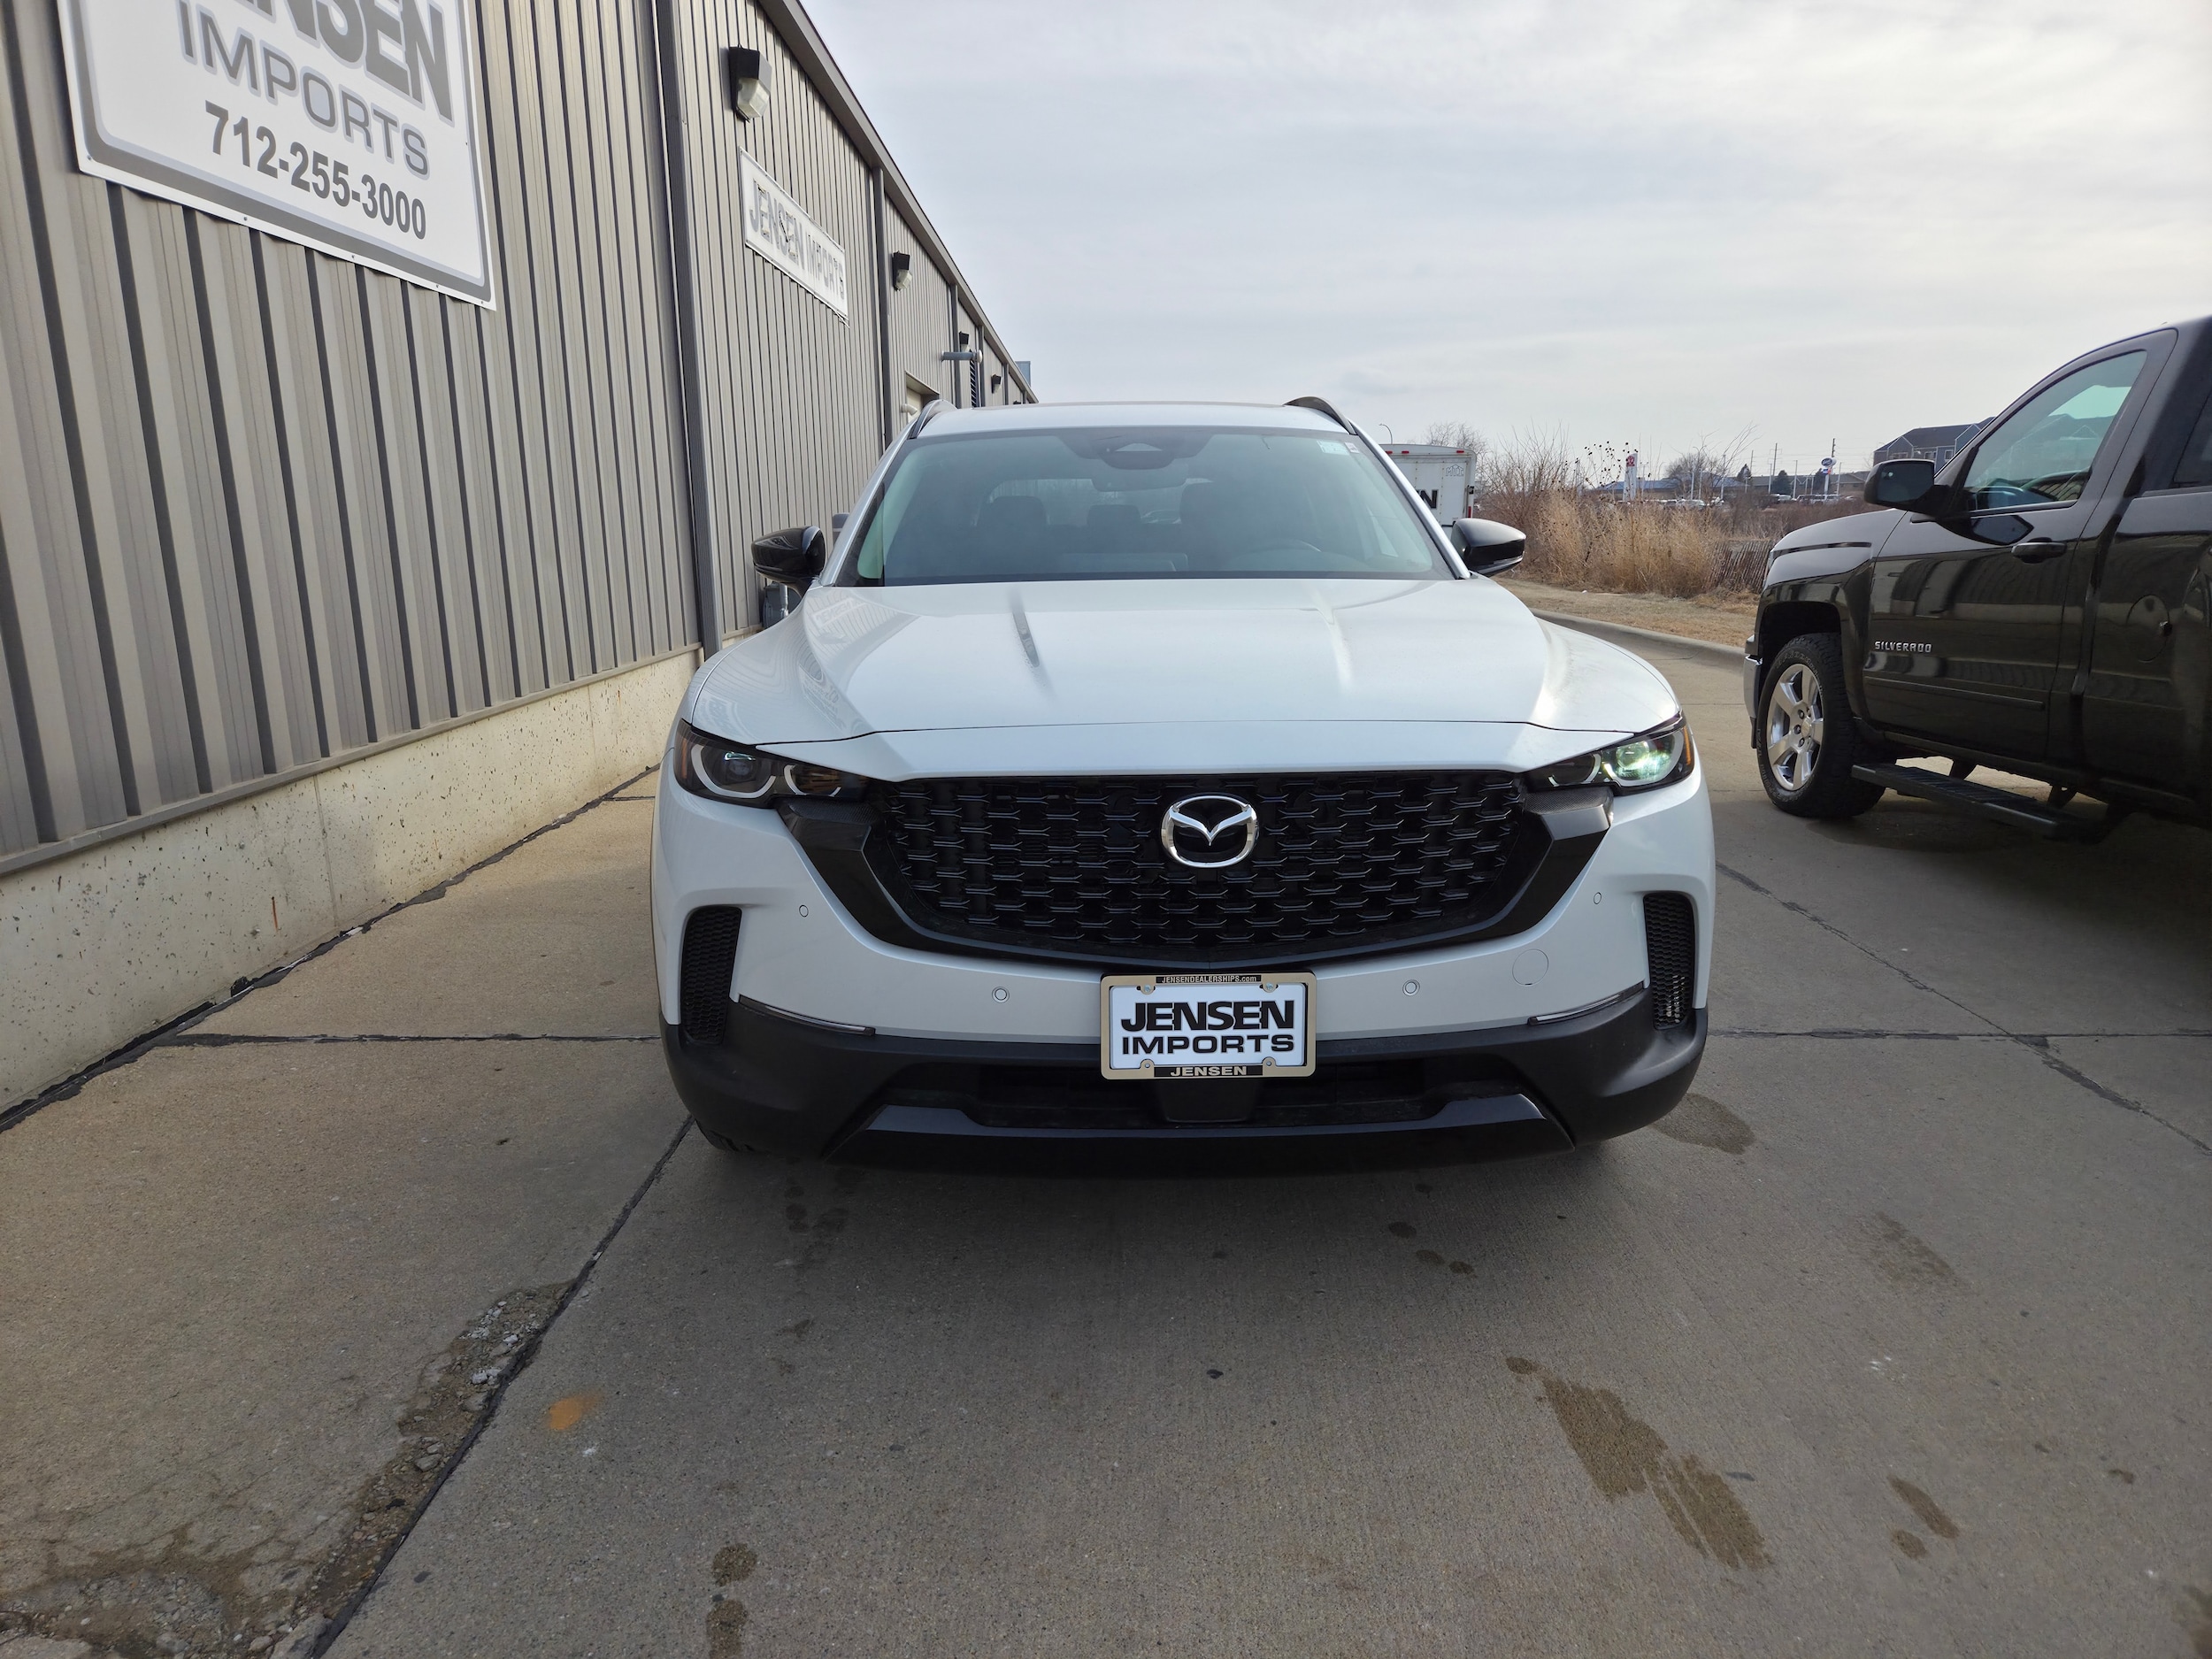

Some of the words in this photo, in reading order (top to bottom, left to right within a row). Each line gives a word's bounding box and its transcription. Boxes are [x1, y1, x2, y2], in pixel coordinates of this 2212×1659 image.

[178, 0, 429, 176] IMPORTS
[205, 100, 426, 240] 712-255-3000
[749, 178, 805, 271] JENSEN
[805, 231, 845, 300] IMPORTS
[1875, 641, 1932, 653] SILVERADO
[1162, 975, 1257, 984] JENSENDEALERSHIPS.com
[1120, 1000, 1295, 1033] JENSEN
[1122, 1033, 1295, 1056] IMPORTS
[1170, 1065, 1248, 1078] JENSEN
